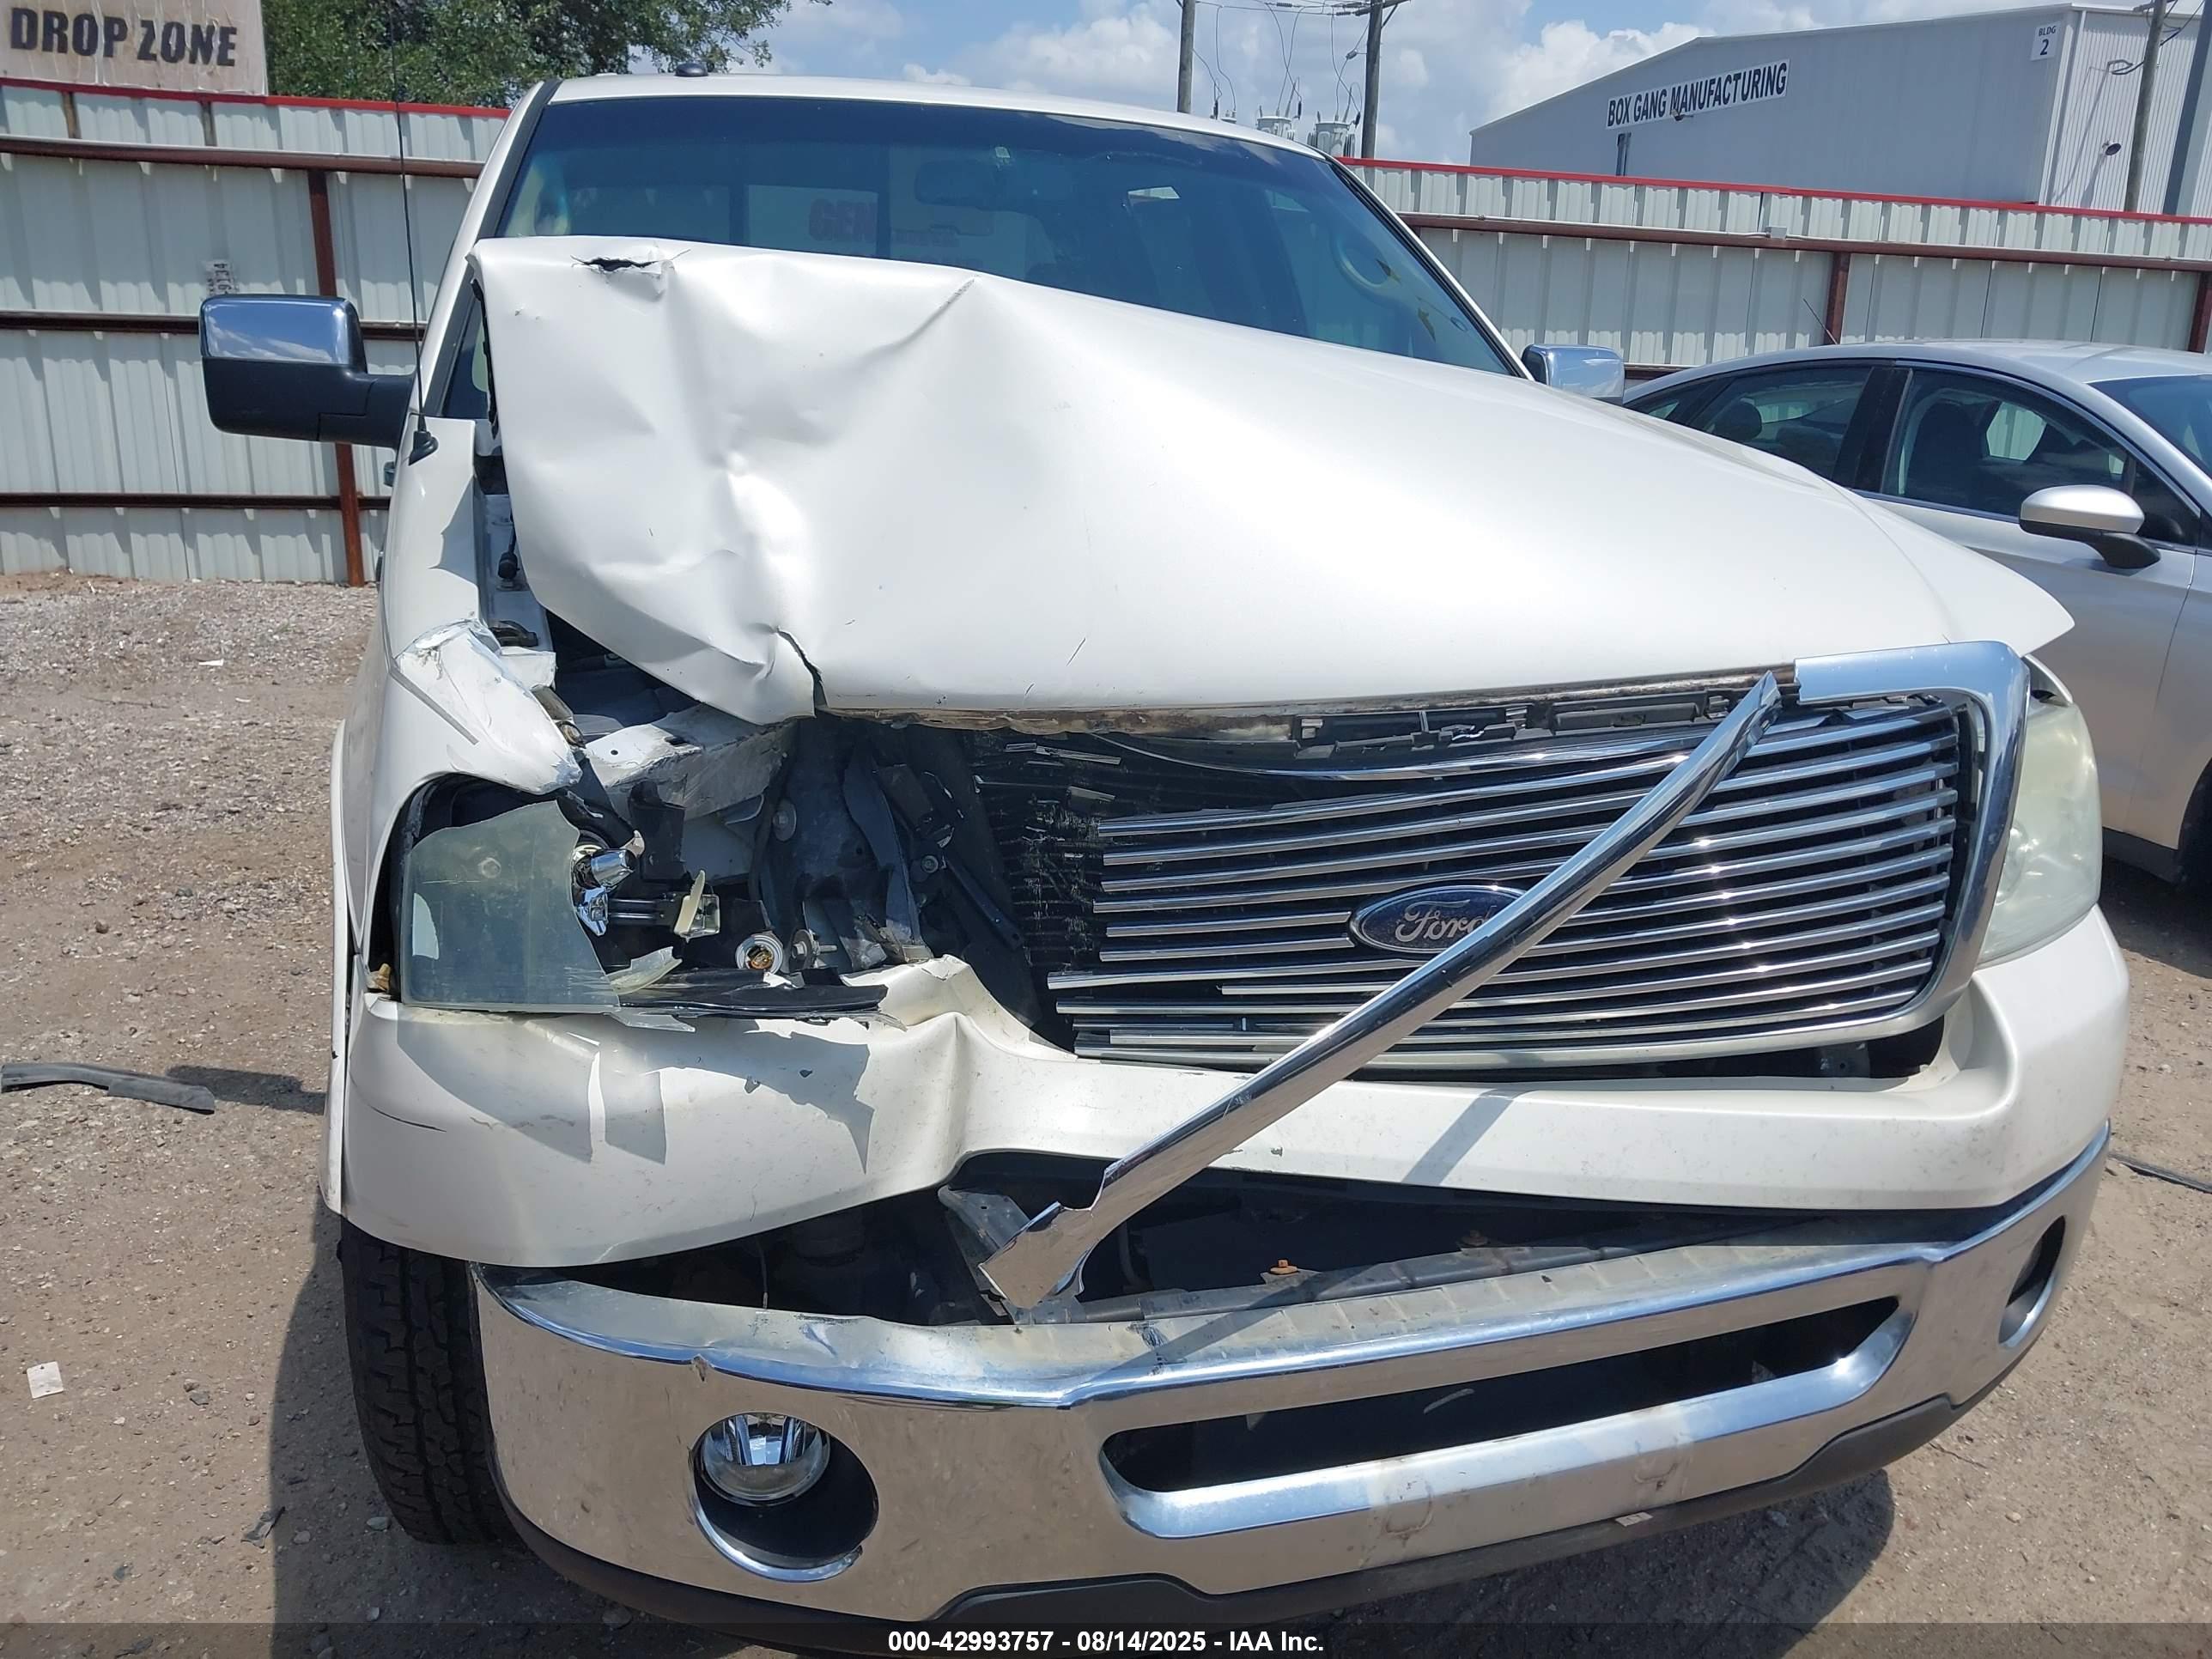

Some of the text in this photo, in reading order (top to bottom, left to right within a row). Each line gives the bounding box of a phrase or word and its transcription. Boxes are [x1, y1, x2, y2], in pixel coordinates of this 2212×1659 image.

[10, 7, 237, 66] DROP ZONE
[2039, 26, 2057, 36] BLDG
[2039, 39, 2049, 56] 2
[1607, 62, 1788, 127] BOX GANG MANUFACTURING
